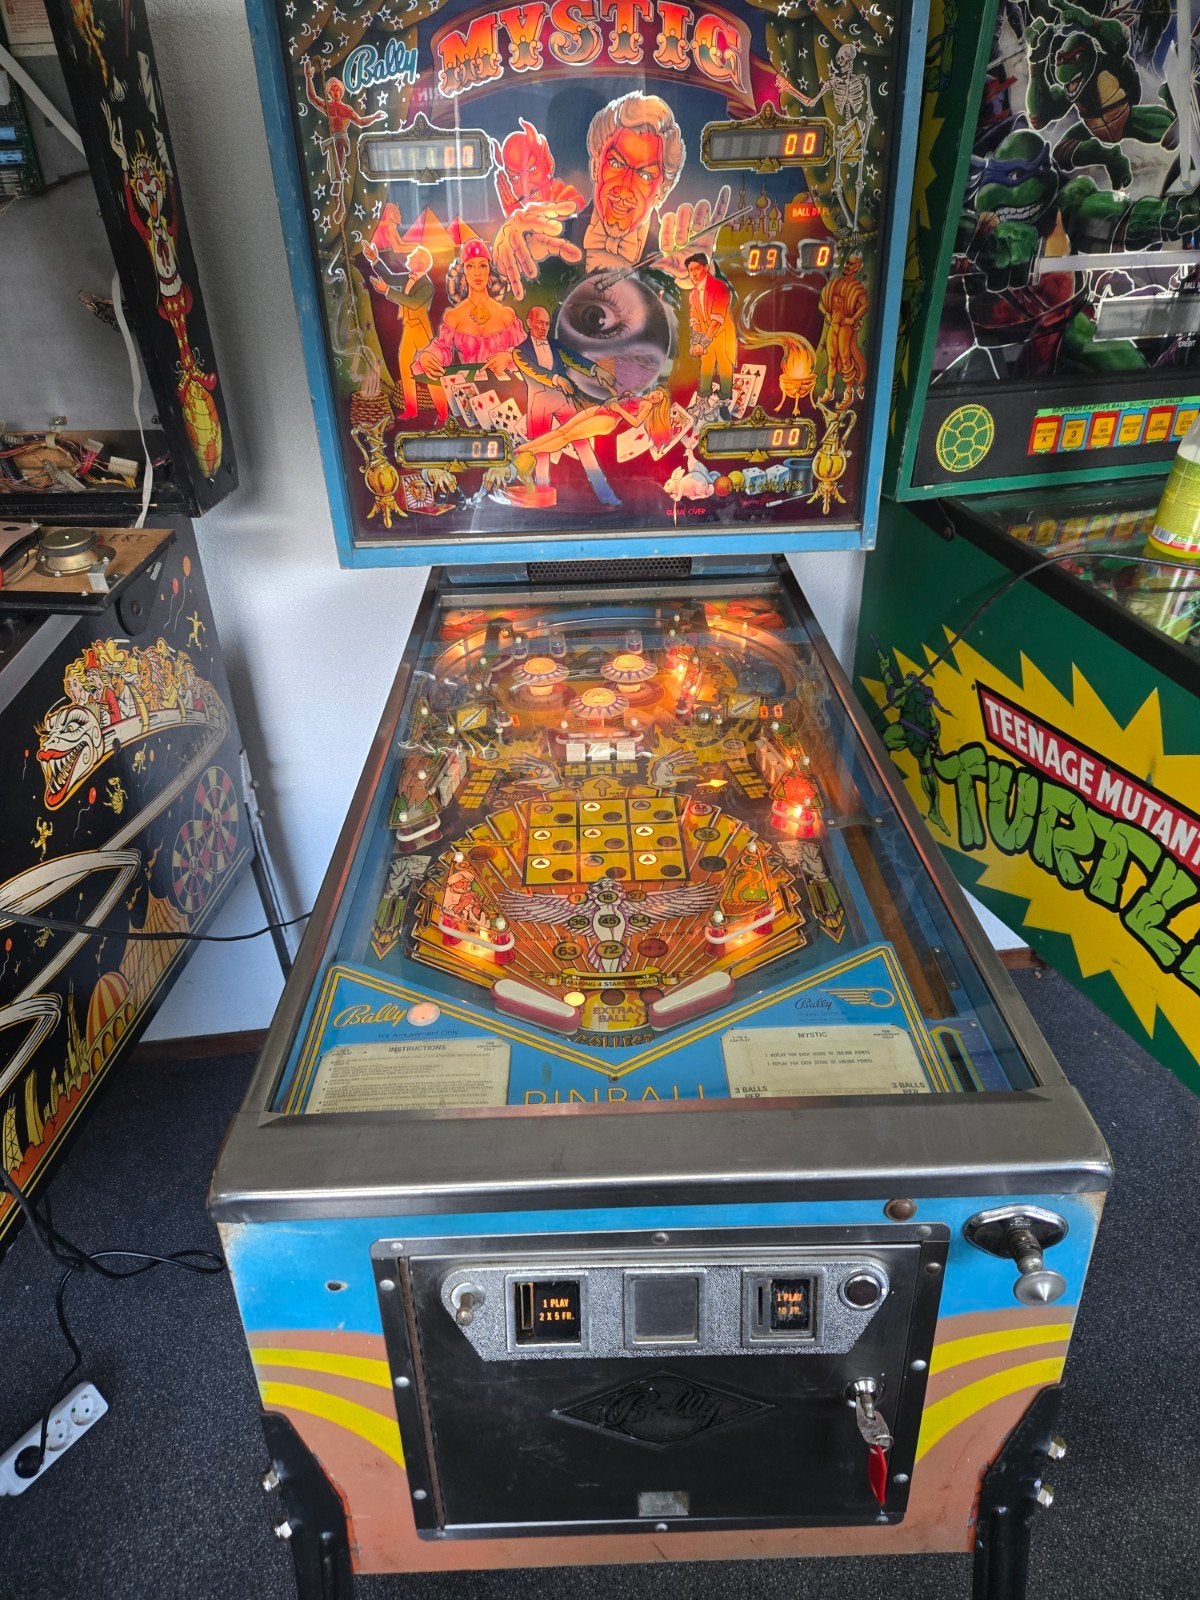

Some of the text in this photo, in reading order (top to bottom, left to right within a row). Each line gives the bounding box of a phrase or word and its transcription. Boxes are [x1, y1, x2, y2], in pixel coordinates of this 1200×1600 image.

[438, 0, 748, 97] MYSTIC
[342, 38, 419, 94] Bally
[784, 132, 817, 156] 00
[792, 207, 810, 217] BALL
[748, 249, 778, 270] 09
[816, 246, 830, 267] 0
[771, 427, 800, 446] 00
[687, 508, 706, 516] OVER
[984, 697, 1095, 795] TEENAGE
[934, 748, 1200, 990] TURTL
[602, 893, 613, 901] 18
[571, 917, 586, 926] 36
[602, 916, 617, 925] 45
[632, 915, 647, 923] 54
[557, 946, 577, 956] 63
[601, 944, 619, 954] 72
[794, 996, 833, 1010] Bally
[333, 1002, 407, 1029] Bally
[593, 1006, 635, 1015] EXTRA
[599, 1014, 631, 1023] BALL
[392, 1030, 440, 1038] Amusement
[574, 1033, 654, 1048] COLLECT
[388, 1044, 446, 1053] INSTRUCTIONS
[742, 1085, 768, 1093] BALLS
[783, 1292, 803, 1302] PLAY
[543, 1298, 569, 1308] 1 PLAY
[778, 1306, 787, 1315] 10
[539, 1311, 575, 1321] 2 X 5 FR.
